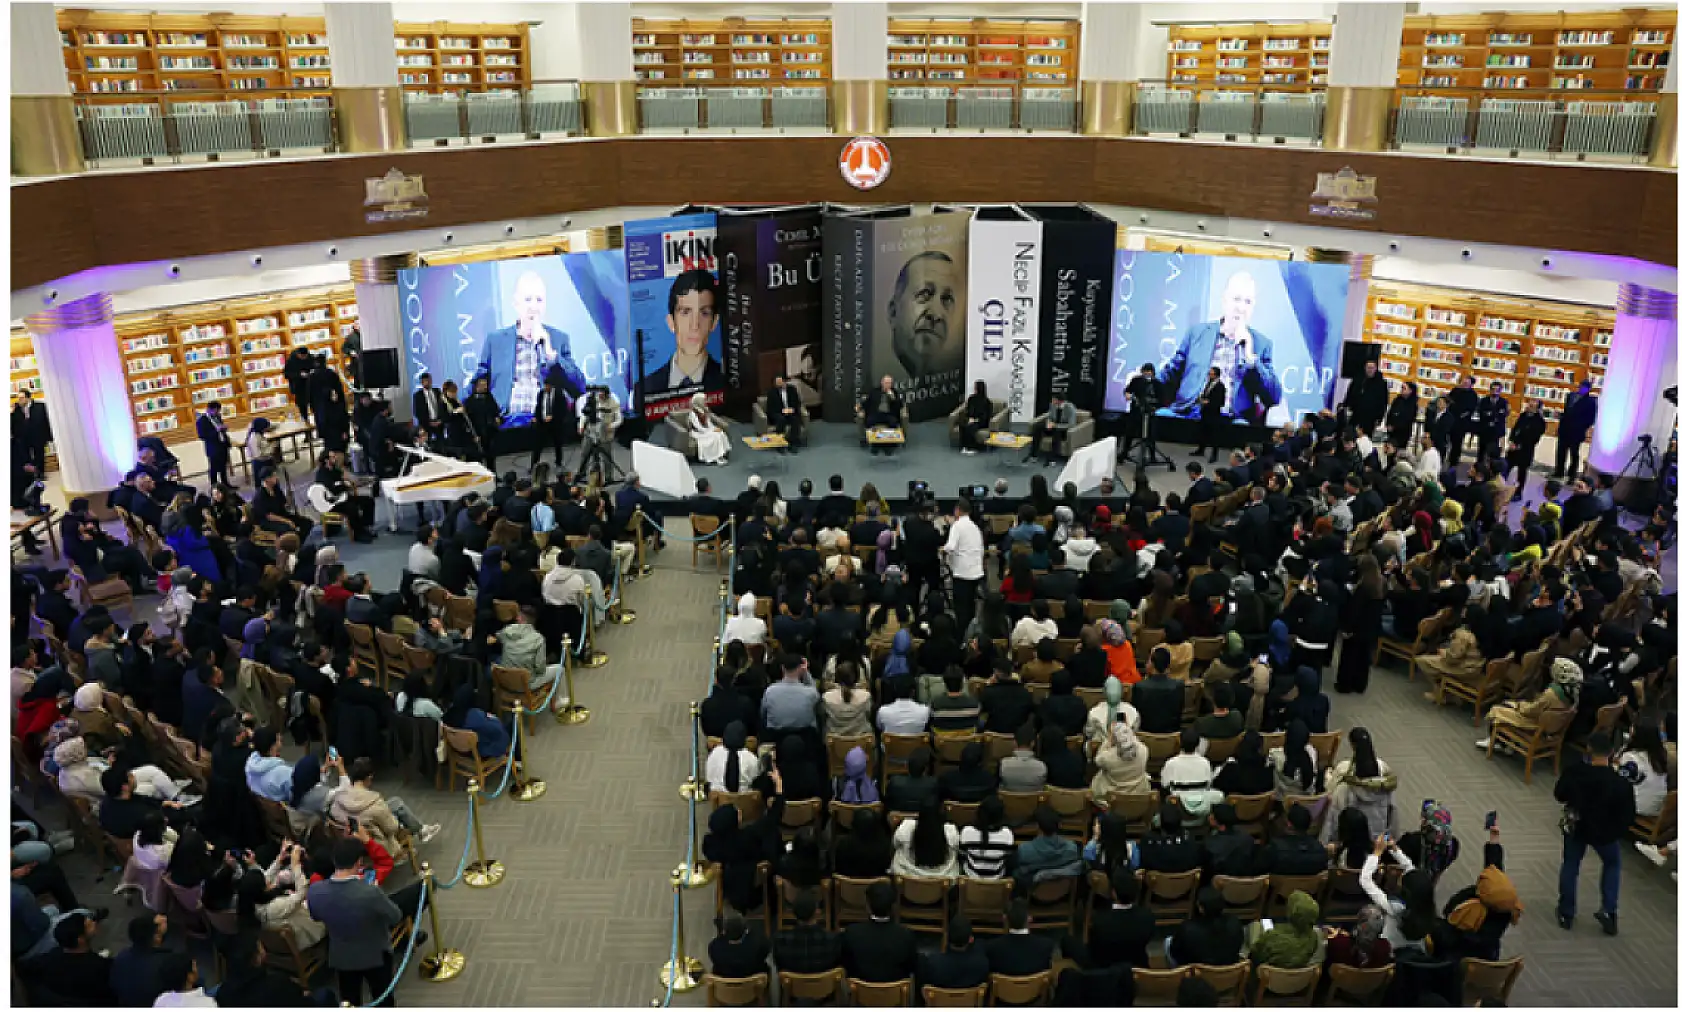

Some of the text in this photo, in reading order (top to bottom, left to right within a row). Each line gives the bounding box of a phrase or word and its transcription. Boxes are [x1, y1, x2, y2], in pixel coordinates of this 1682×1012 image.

[766, 263, 798, 290] Bu
[978, 299, 1009, 361] ÇİLE
[1053, 269, 1077, 361] Sabahattin
[584, 348, 628, 380] CEP
[1281, 366, 1333, 394] CEP
